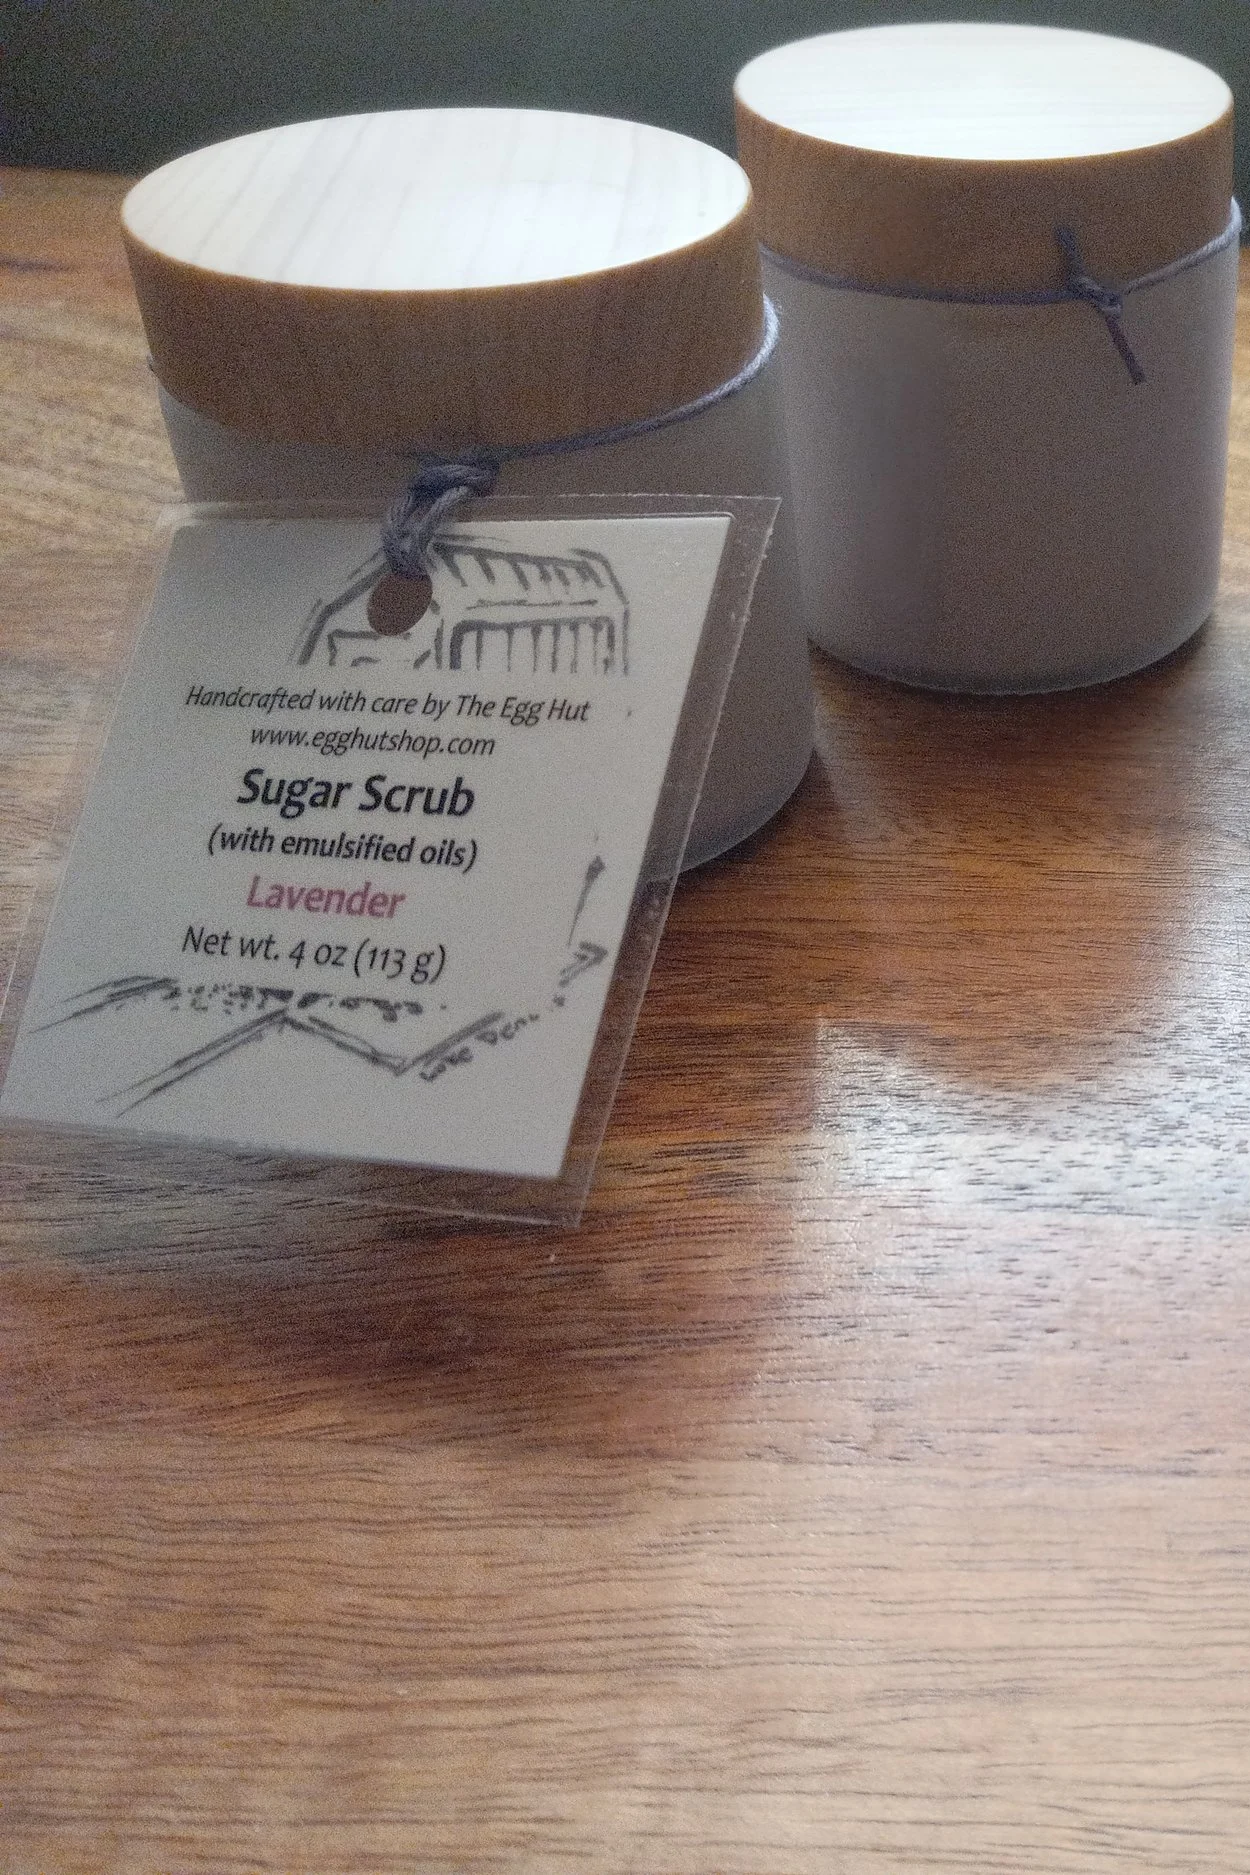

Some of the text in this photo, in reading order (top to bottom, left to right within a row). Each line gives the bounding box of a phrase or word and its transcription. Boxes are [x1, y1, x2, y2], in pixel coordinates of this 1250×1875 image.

[185, 686, 591, 727] Handcrafted with care by The Egg Hut
[251, 727, 496, 758] www.egghutshop.com
[236, 767, 475, 819] Sugar Scrub
[207, 823, 478, 874] (with emulsified oils)
[247, 876, 405, 918] Lavender
[182, 926, 446, 985] Net wt. 4 oz (113 g)
